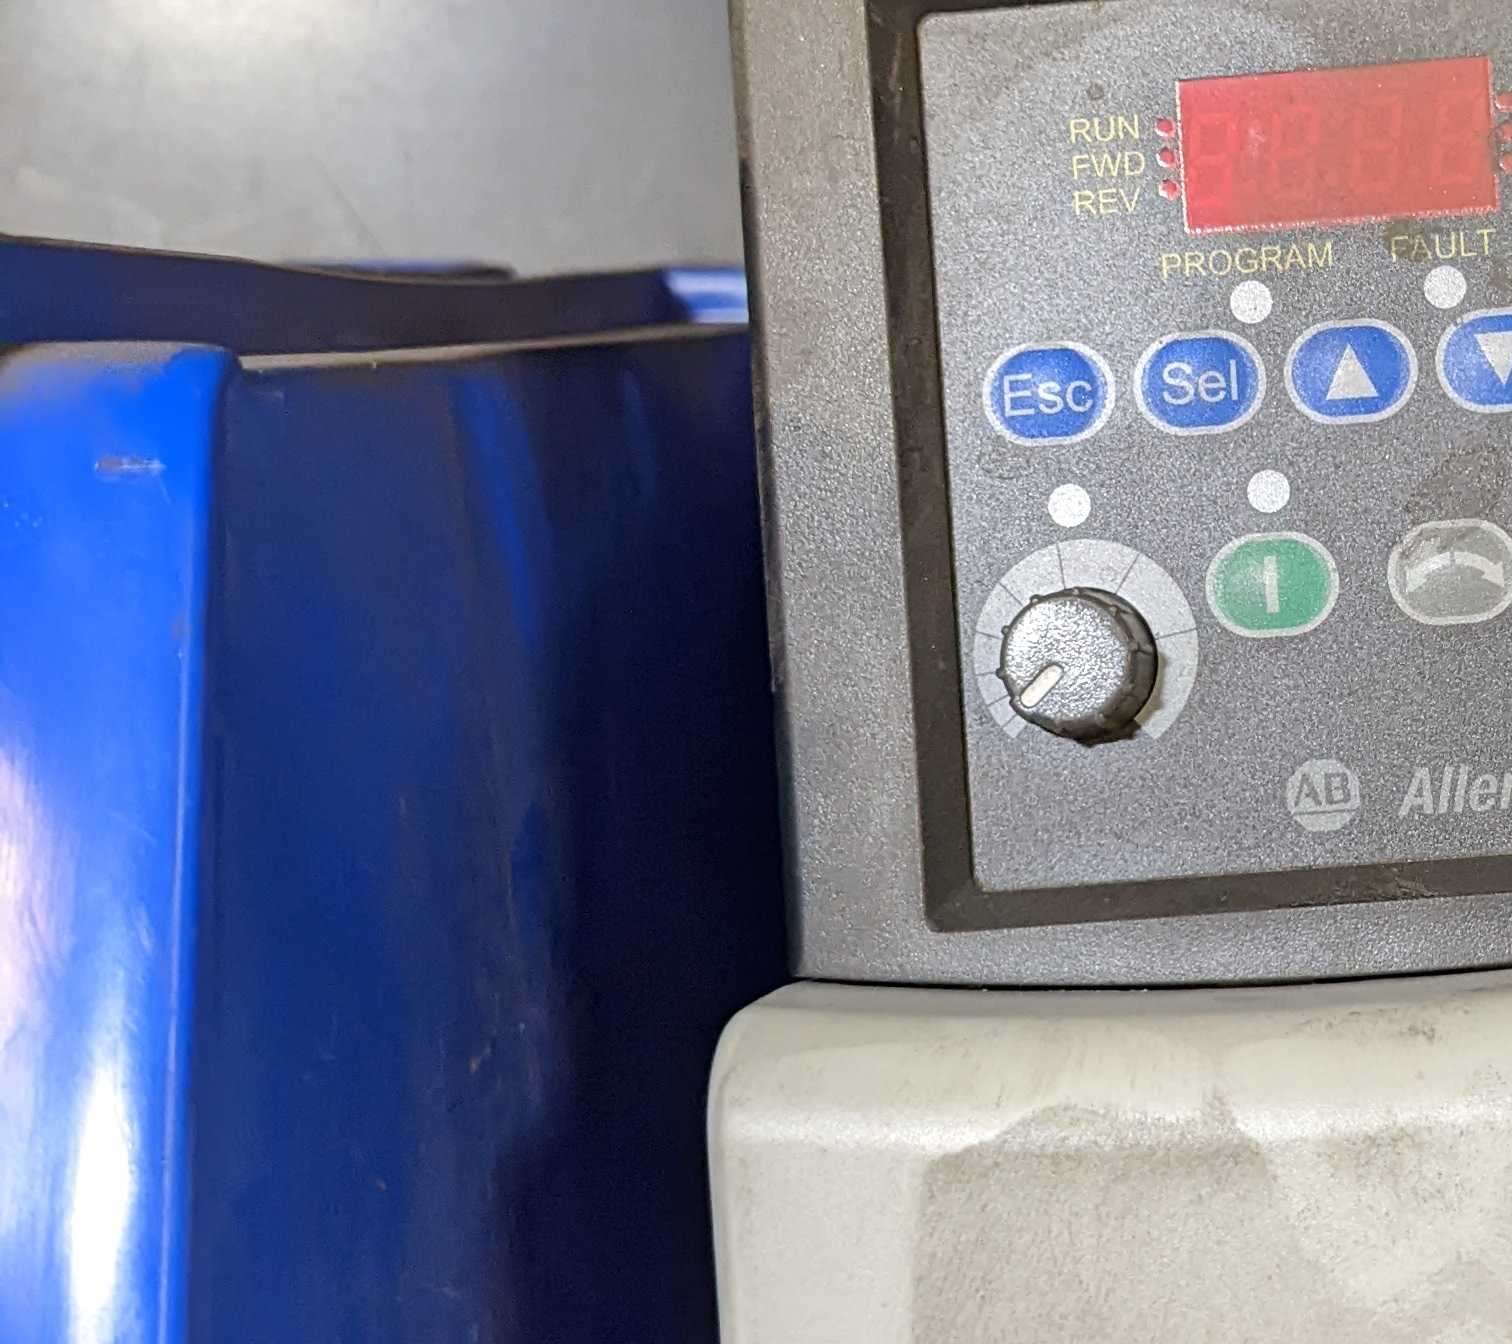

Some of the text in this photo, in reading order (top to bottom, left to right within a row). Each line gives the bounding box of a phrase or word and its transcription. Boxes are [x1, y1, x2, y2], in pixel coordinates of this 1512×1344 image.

[1069, 115, 1140, 144] RUN
[1072, 151, 1146, 179] FWD
[1074, 186, 1140, 216] REV
[1160, 240, 1334, 279] PROGRAM
[1391, 228, 1497, 261] FAULT
[1002, 371, 1095, 417] Esc
[1162, 361, 1238, 407] Sel
[1291, 767, 1352, 810] AB
